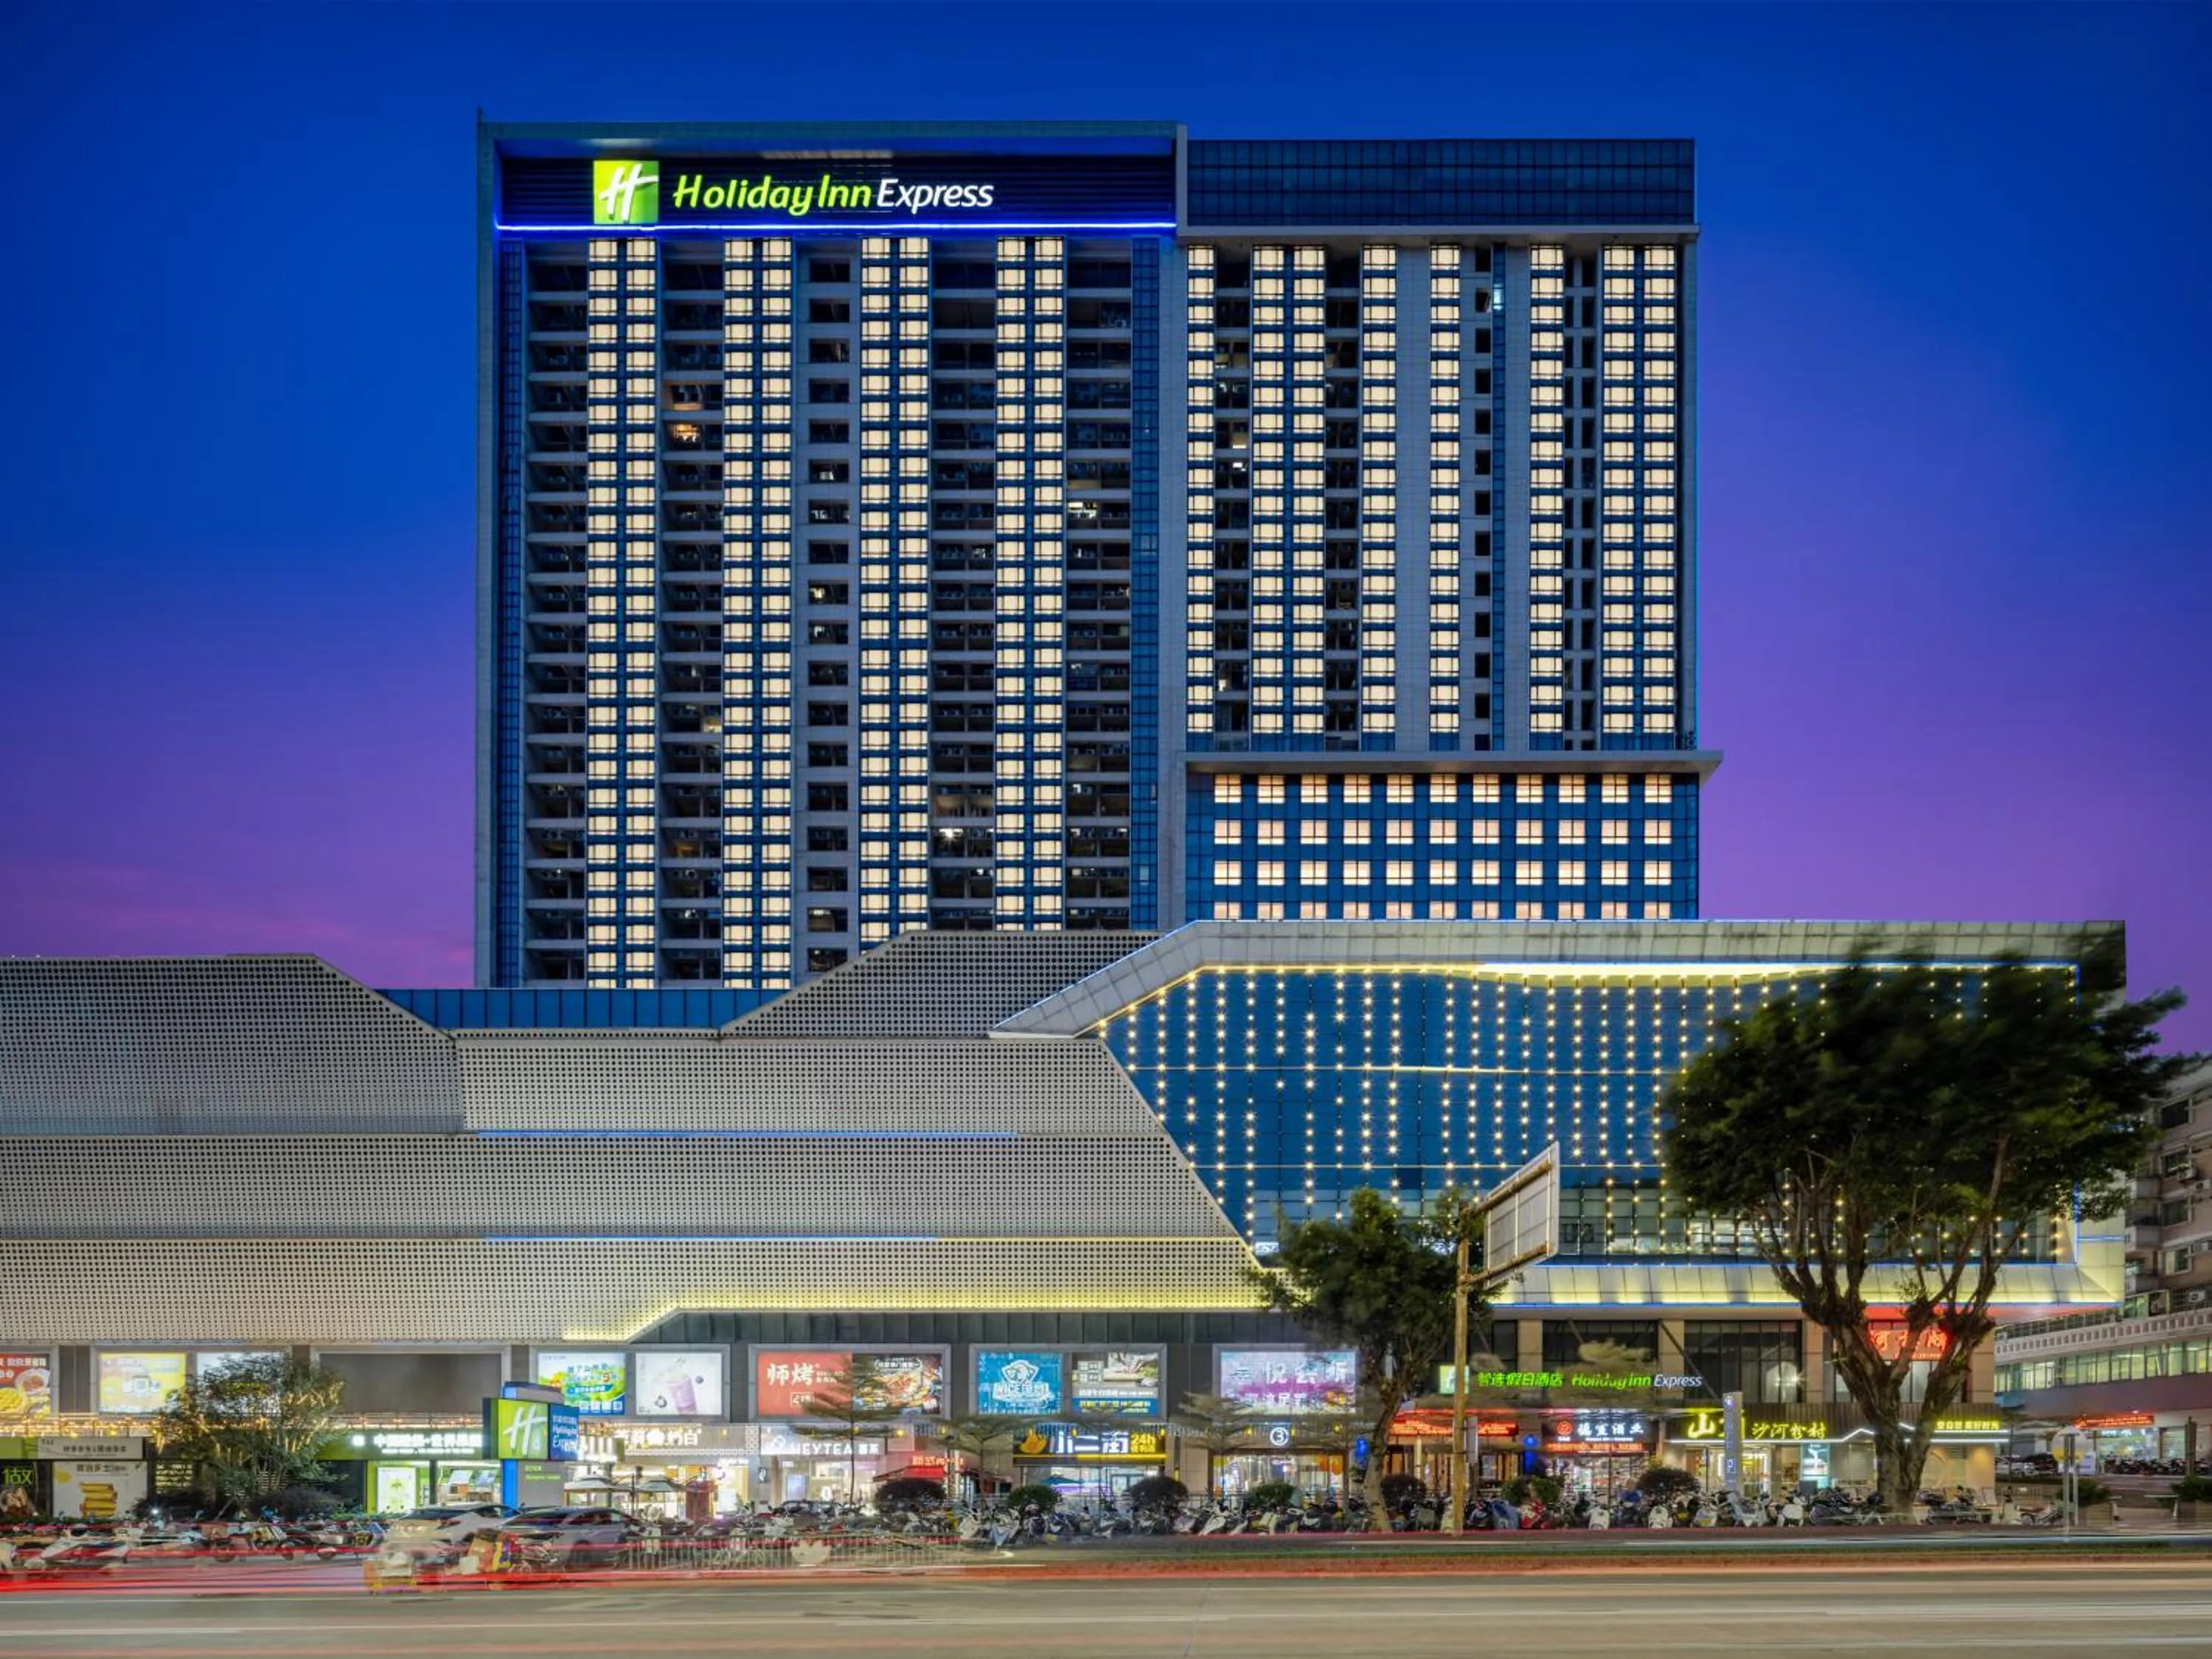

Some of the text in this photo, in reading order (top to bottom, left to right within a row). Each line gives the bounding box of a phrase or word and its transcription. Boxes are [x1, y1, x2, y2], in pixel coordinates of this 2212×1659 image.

[672, 174, 995, 216] Holiday Inn Express
[767, 1363, 814, 1386] 师烤
[1478, 1371, 1564, 1388] 智选假日酒店
[1571, 1374, 1703, 1390] Holiday Inn Express
